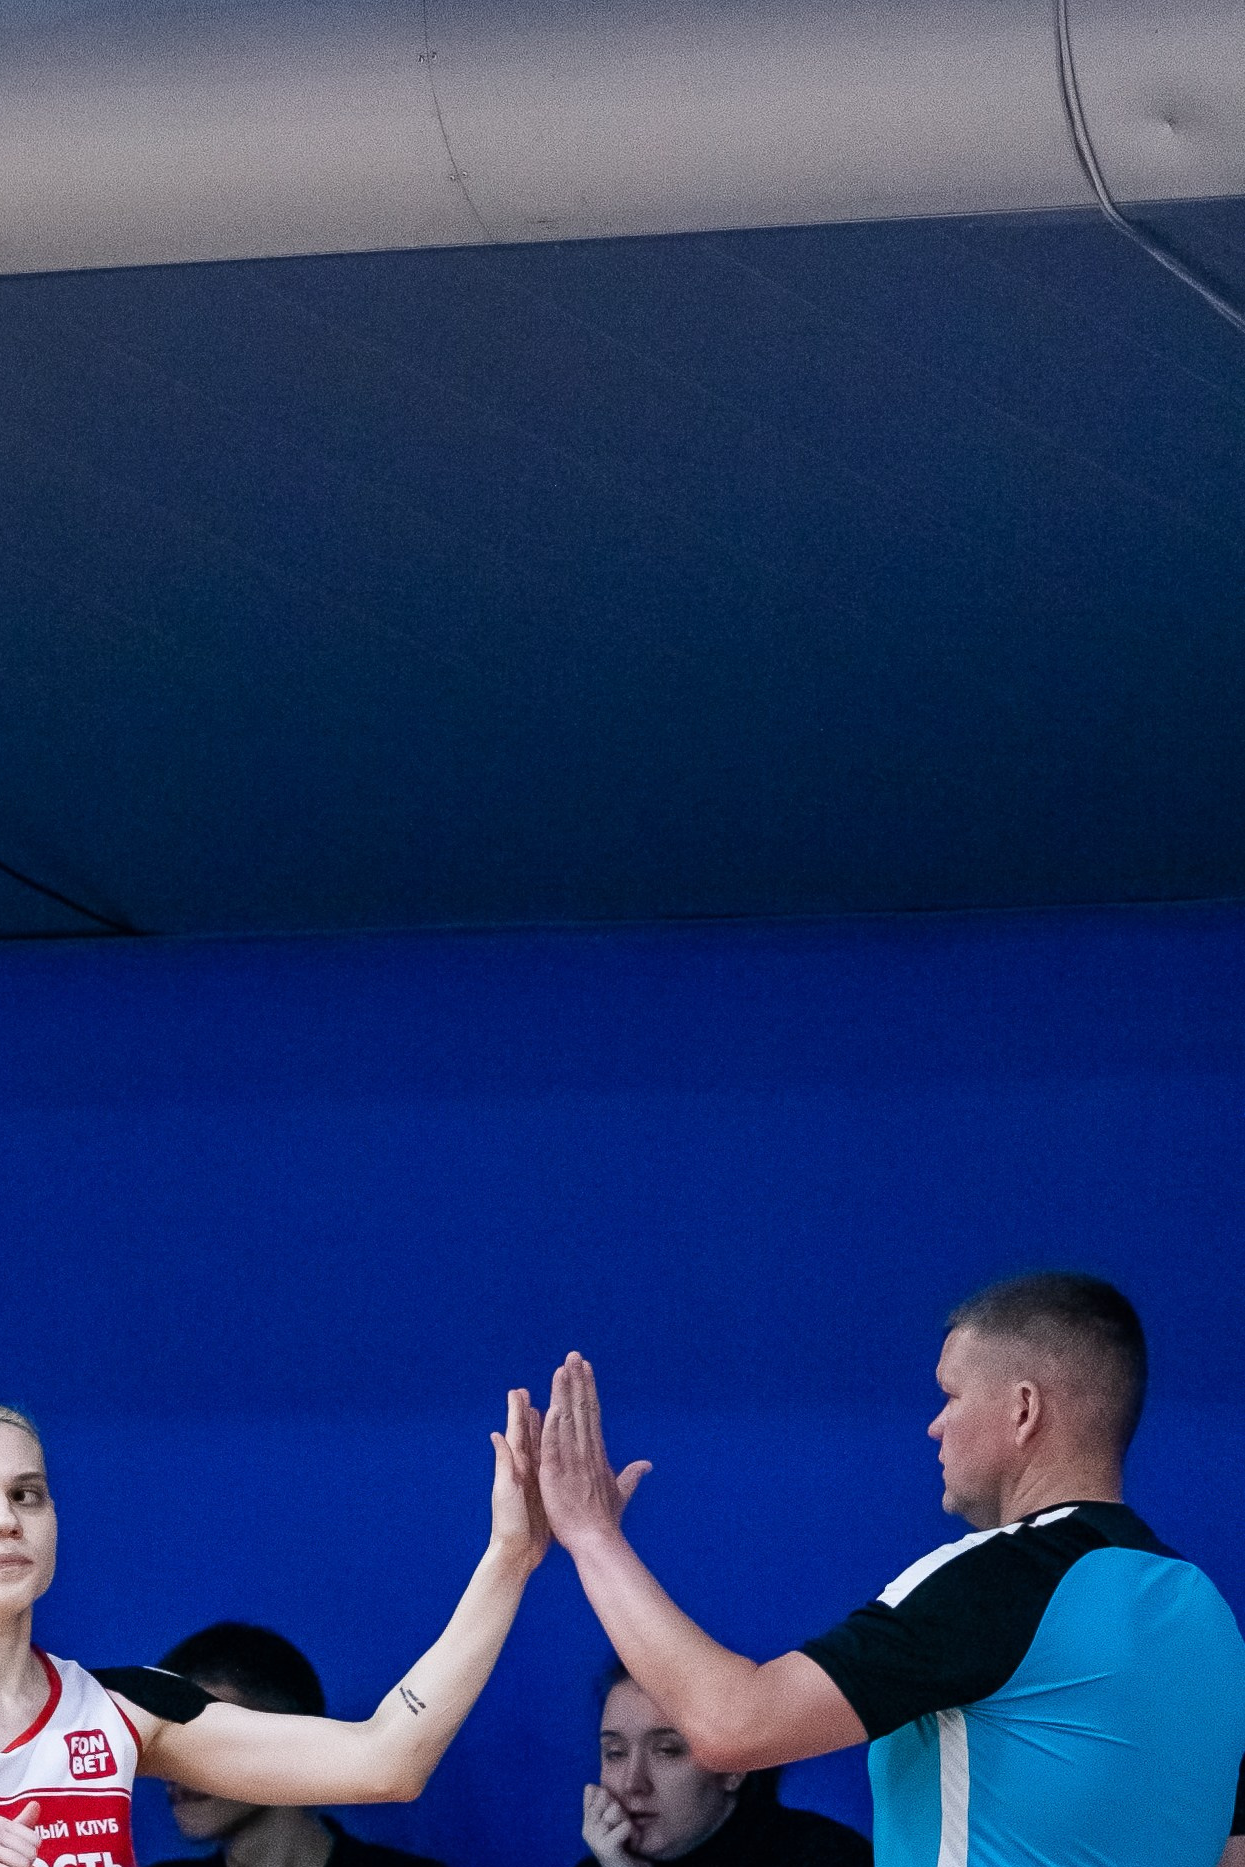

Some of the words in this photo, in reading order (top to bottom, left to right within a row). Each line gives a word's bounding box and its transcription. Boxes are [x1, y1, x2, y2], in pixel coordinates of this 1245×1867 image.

[71, 1734, 105, 1755] FON
[72, 1752, 110, 1774] BET
[75, 1818, 119, 1837] КЛУБ
